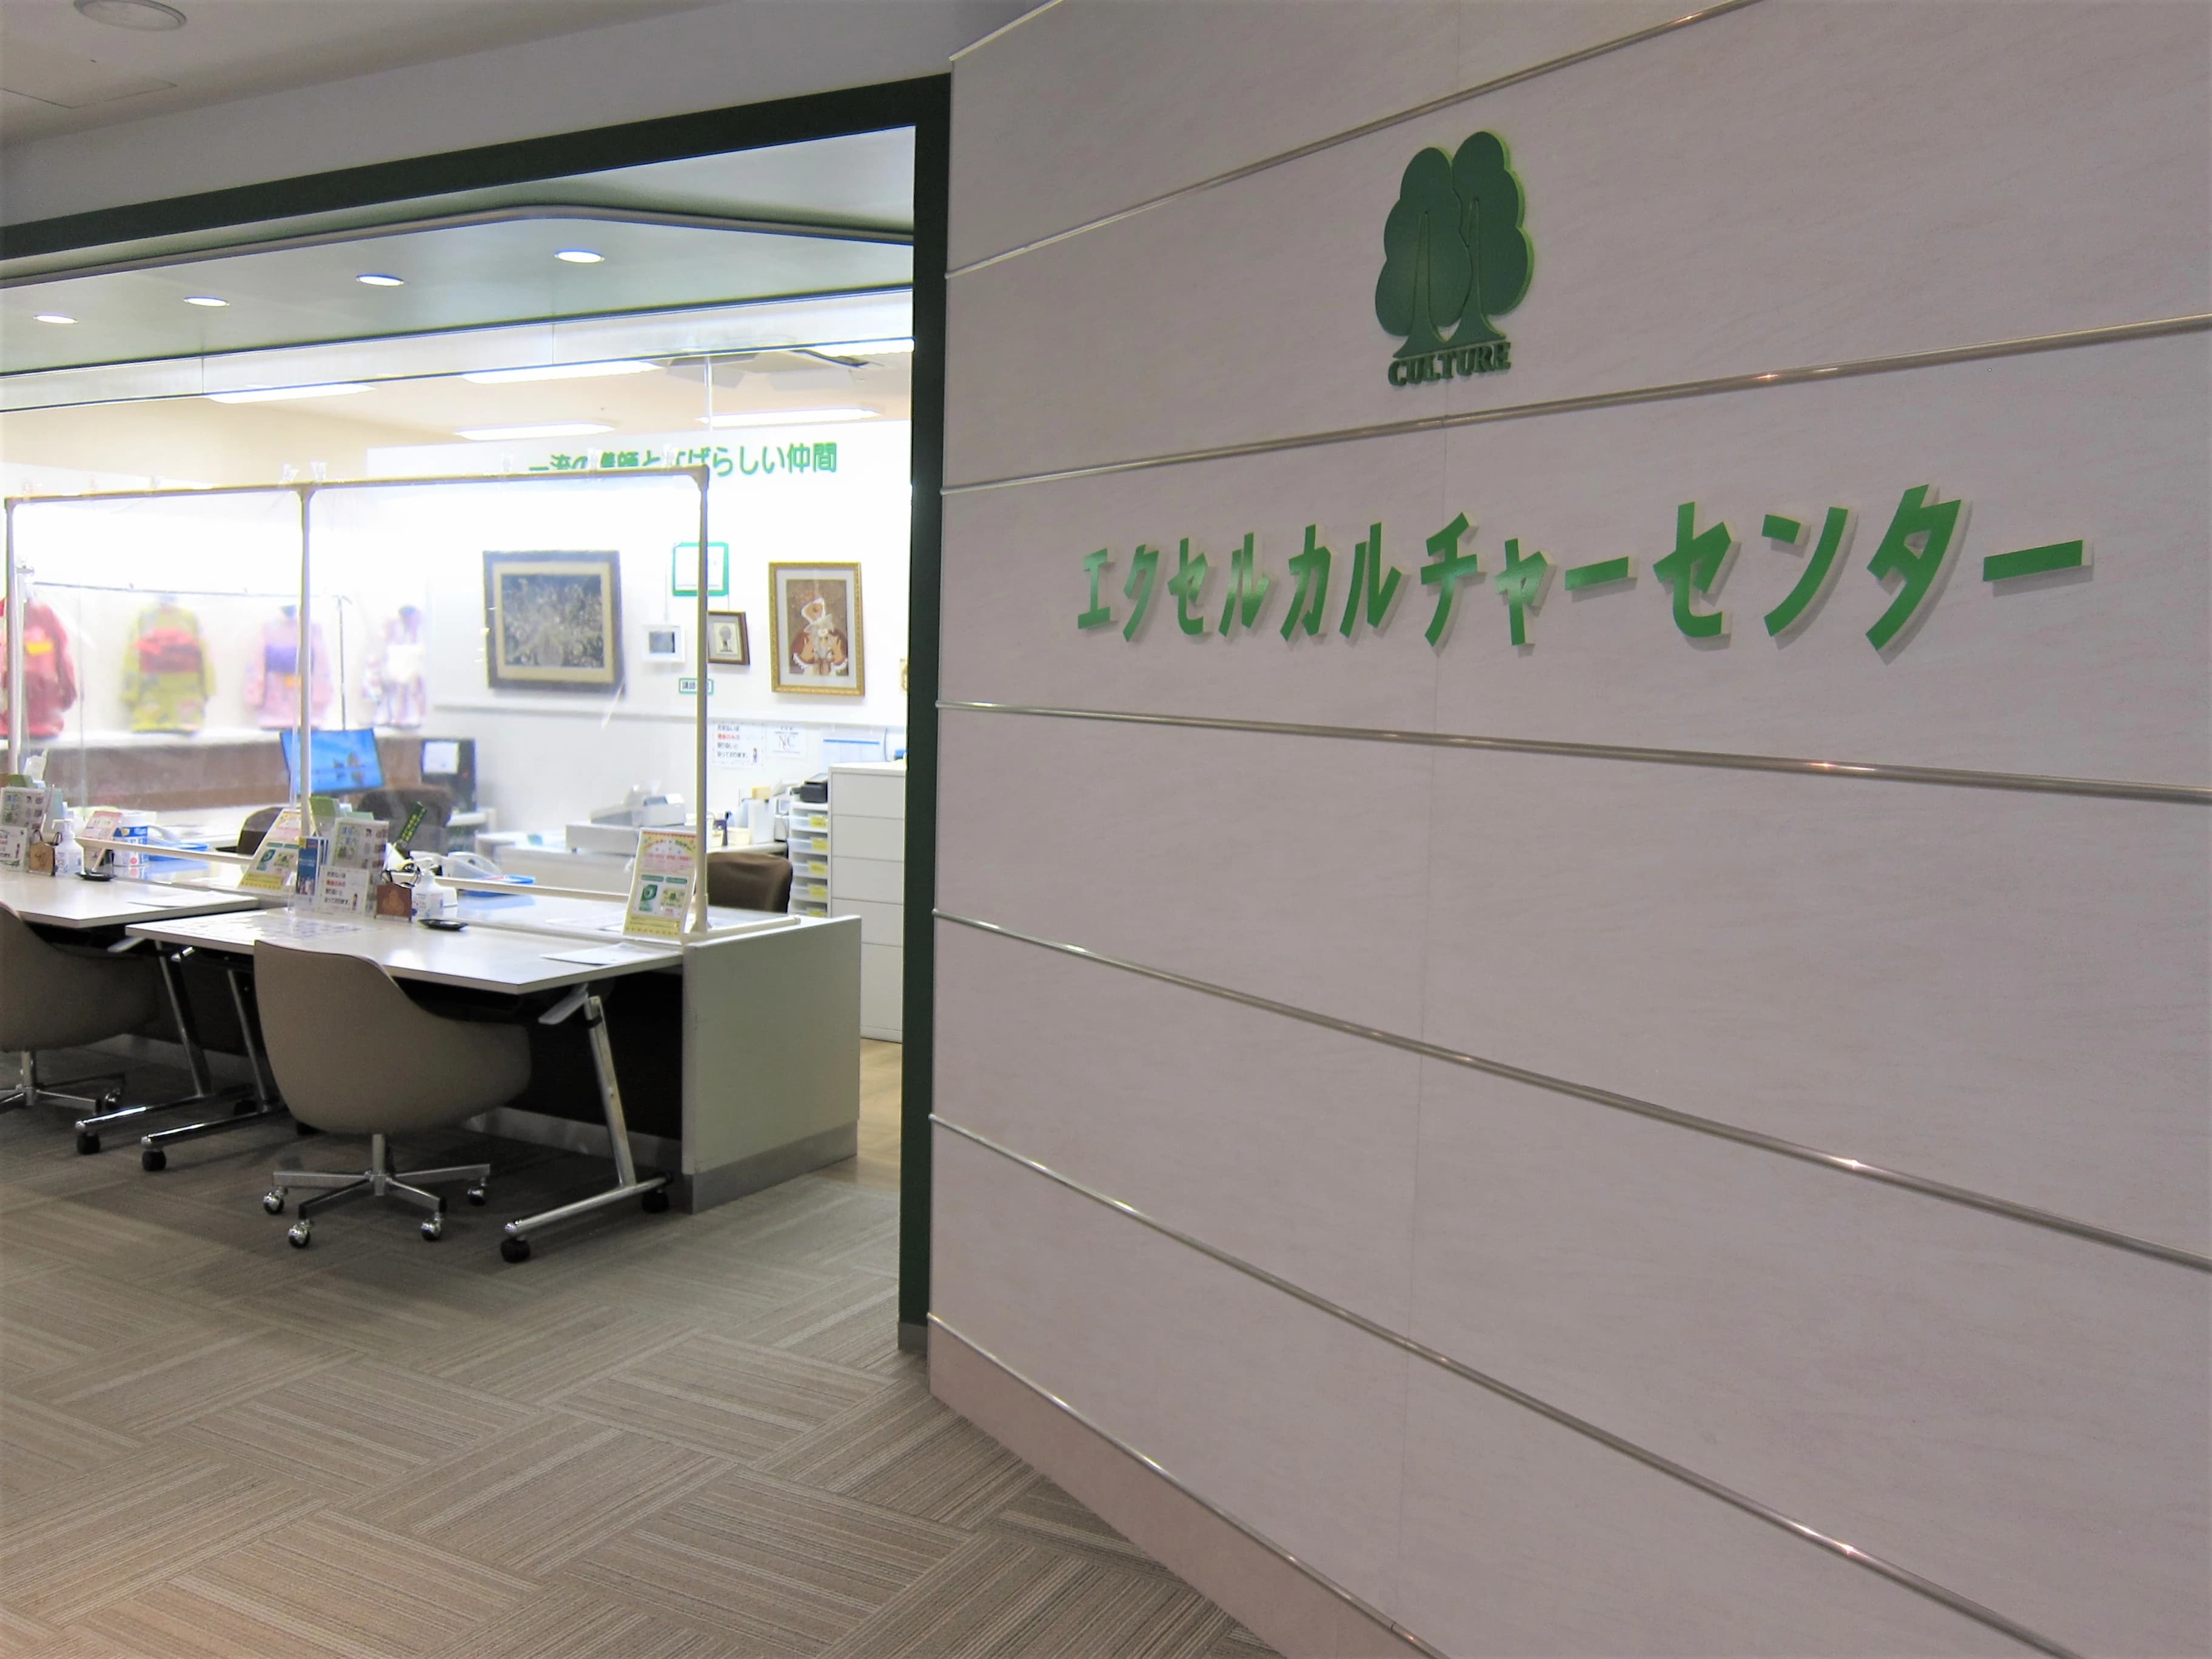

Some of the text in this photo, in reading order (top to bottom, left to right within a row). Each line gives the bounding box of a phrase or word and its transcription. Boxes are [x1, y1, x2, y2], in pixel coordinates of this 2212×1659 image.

[1388, 343, 1511, 386] CULTURE
[1078, 484, 2086, 652] エクセルカルチャーセンター
